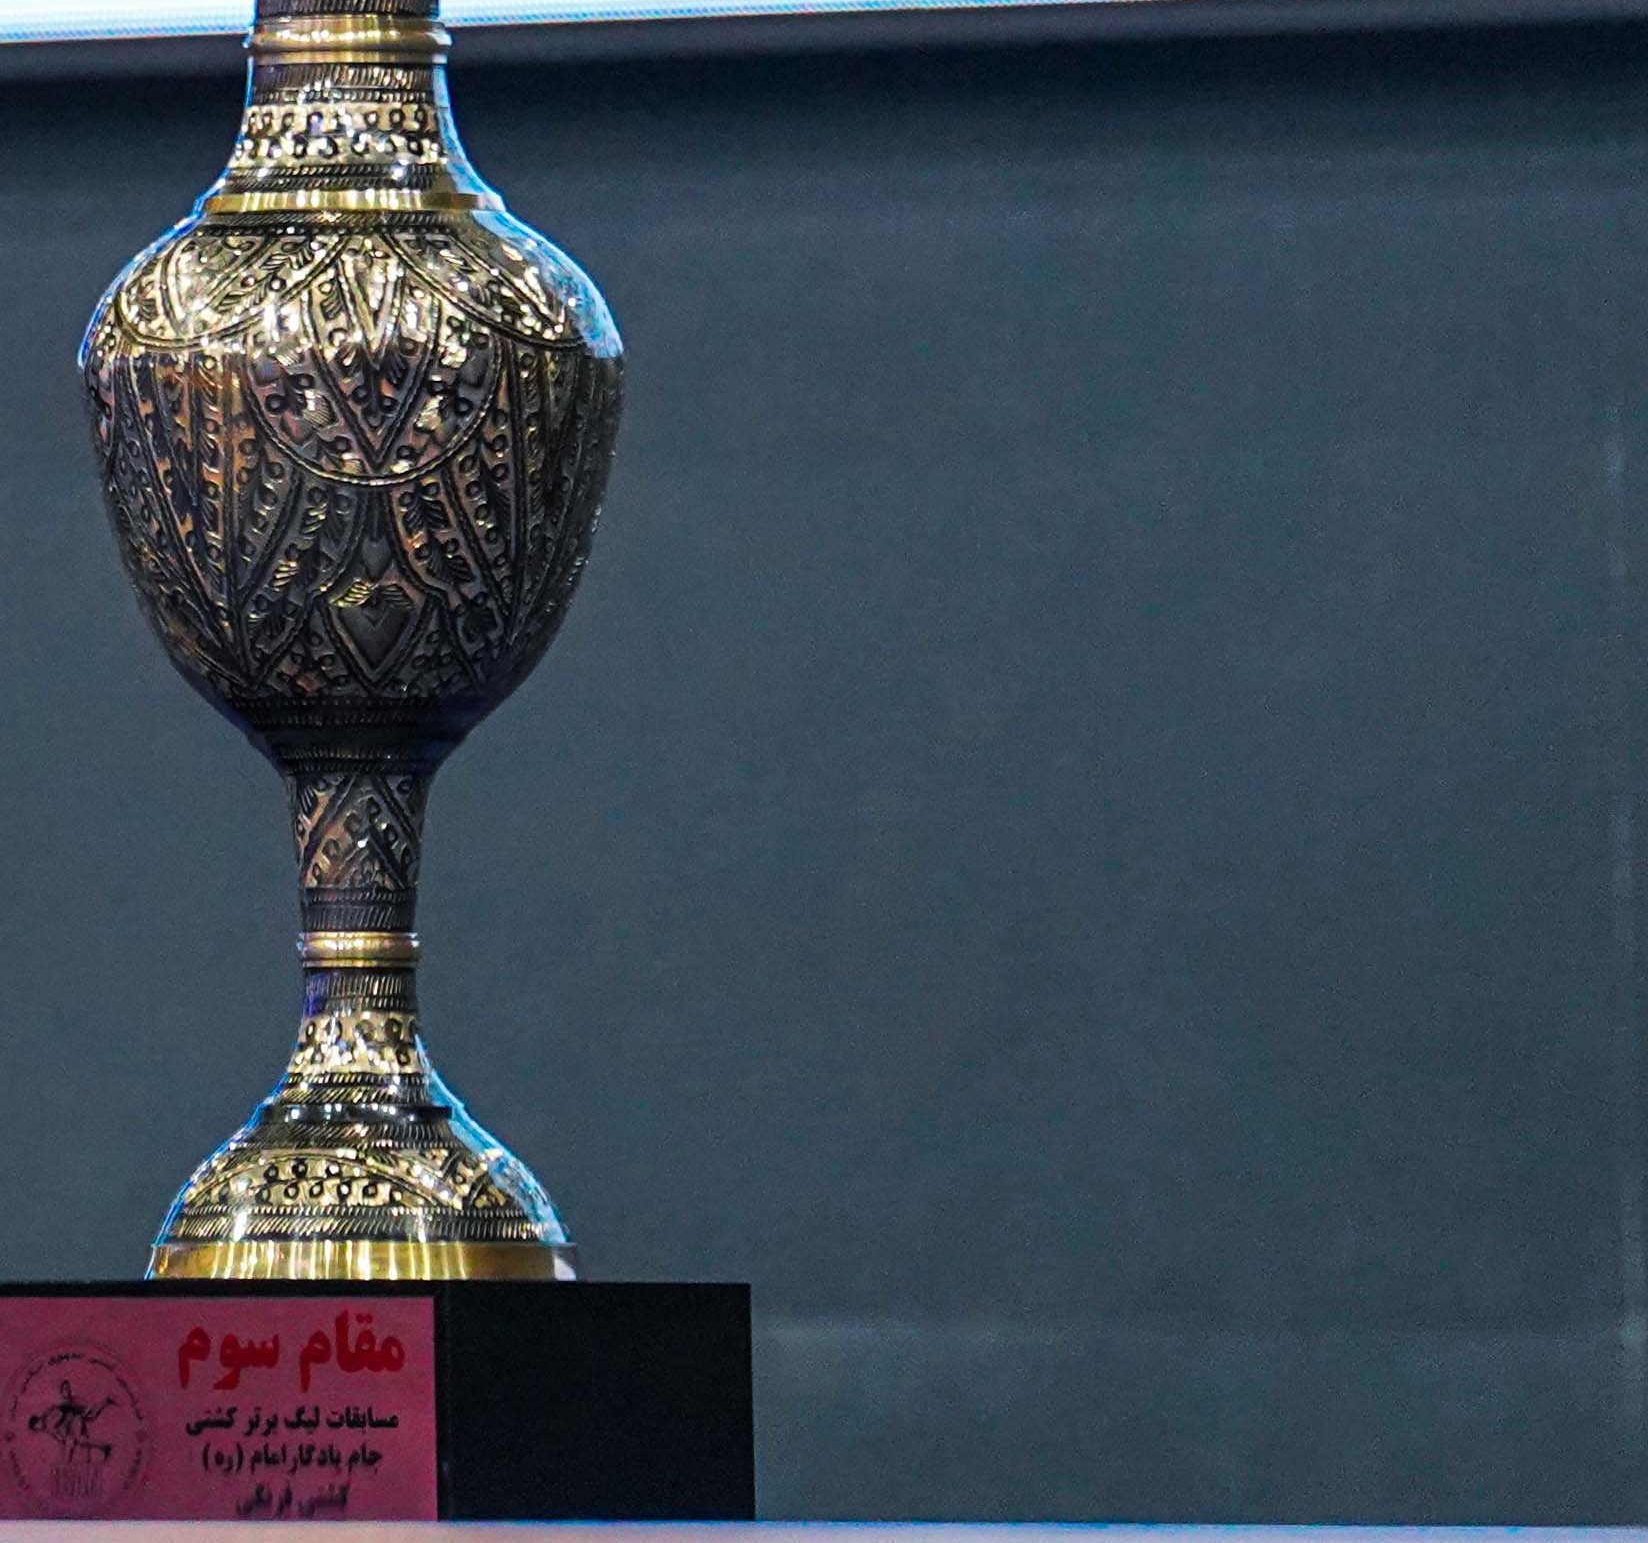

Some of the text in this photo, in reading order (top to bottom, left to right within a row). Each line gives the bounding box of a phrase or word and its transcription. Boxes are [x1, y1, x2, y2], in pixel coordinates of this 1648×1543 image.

[179, 1310, 405, 1393] مقام سوم
[186, 1407, 237, 1435] کشتی
[244, 1406, 278, 1436] برتر
[326, 1406, 399, 1433] مسابقات
[251, 1444, 286, 1473] امام
[348, 1444, 383, 1474] جام
